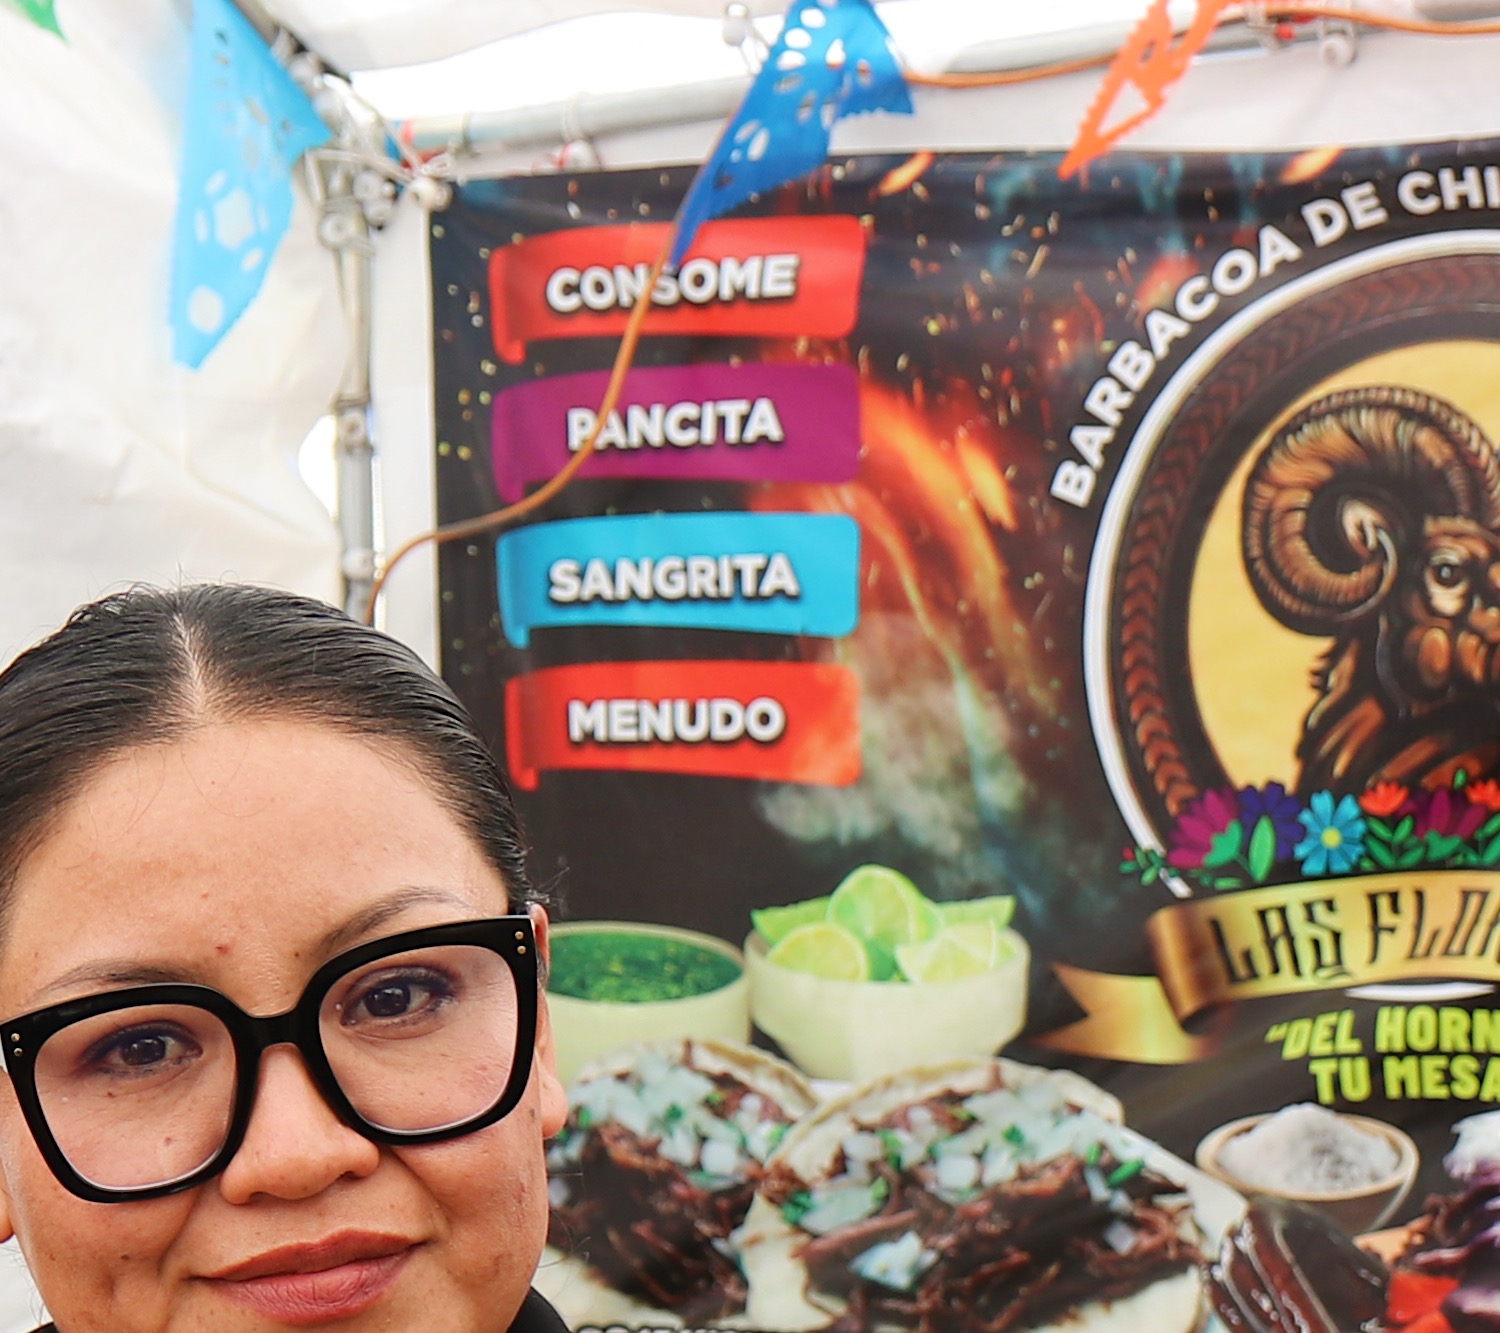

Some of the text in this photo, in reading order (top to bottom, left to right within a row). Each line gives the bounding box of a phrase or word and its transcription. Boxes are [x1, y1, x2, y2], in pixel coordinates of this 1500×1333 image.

[545, 254, 800, 312] CONSOME
[1051, 226, 1302, 509] BARBACOA
[1301, 181, 1388, 247] DE
[566, 397, 784, 452] PANCITA
[548, 553, 800, 603] SANGRITA
[567, 697, 786, 743] MENUDO
[1209, 895, 1350, 983] LAS
[1308, 1059, 1371, 1106] TU
